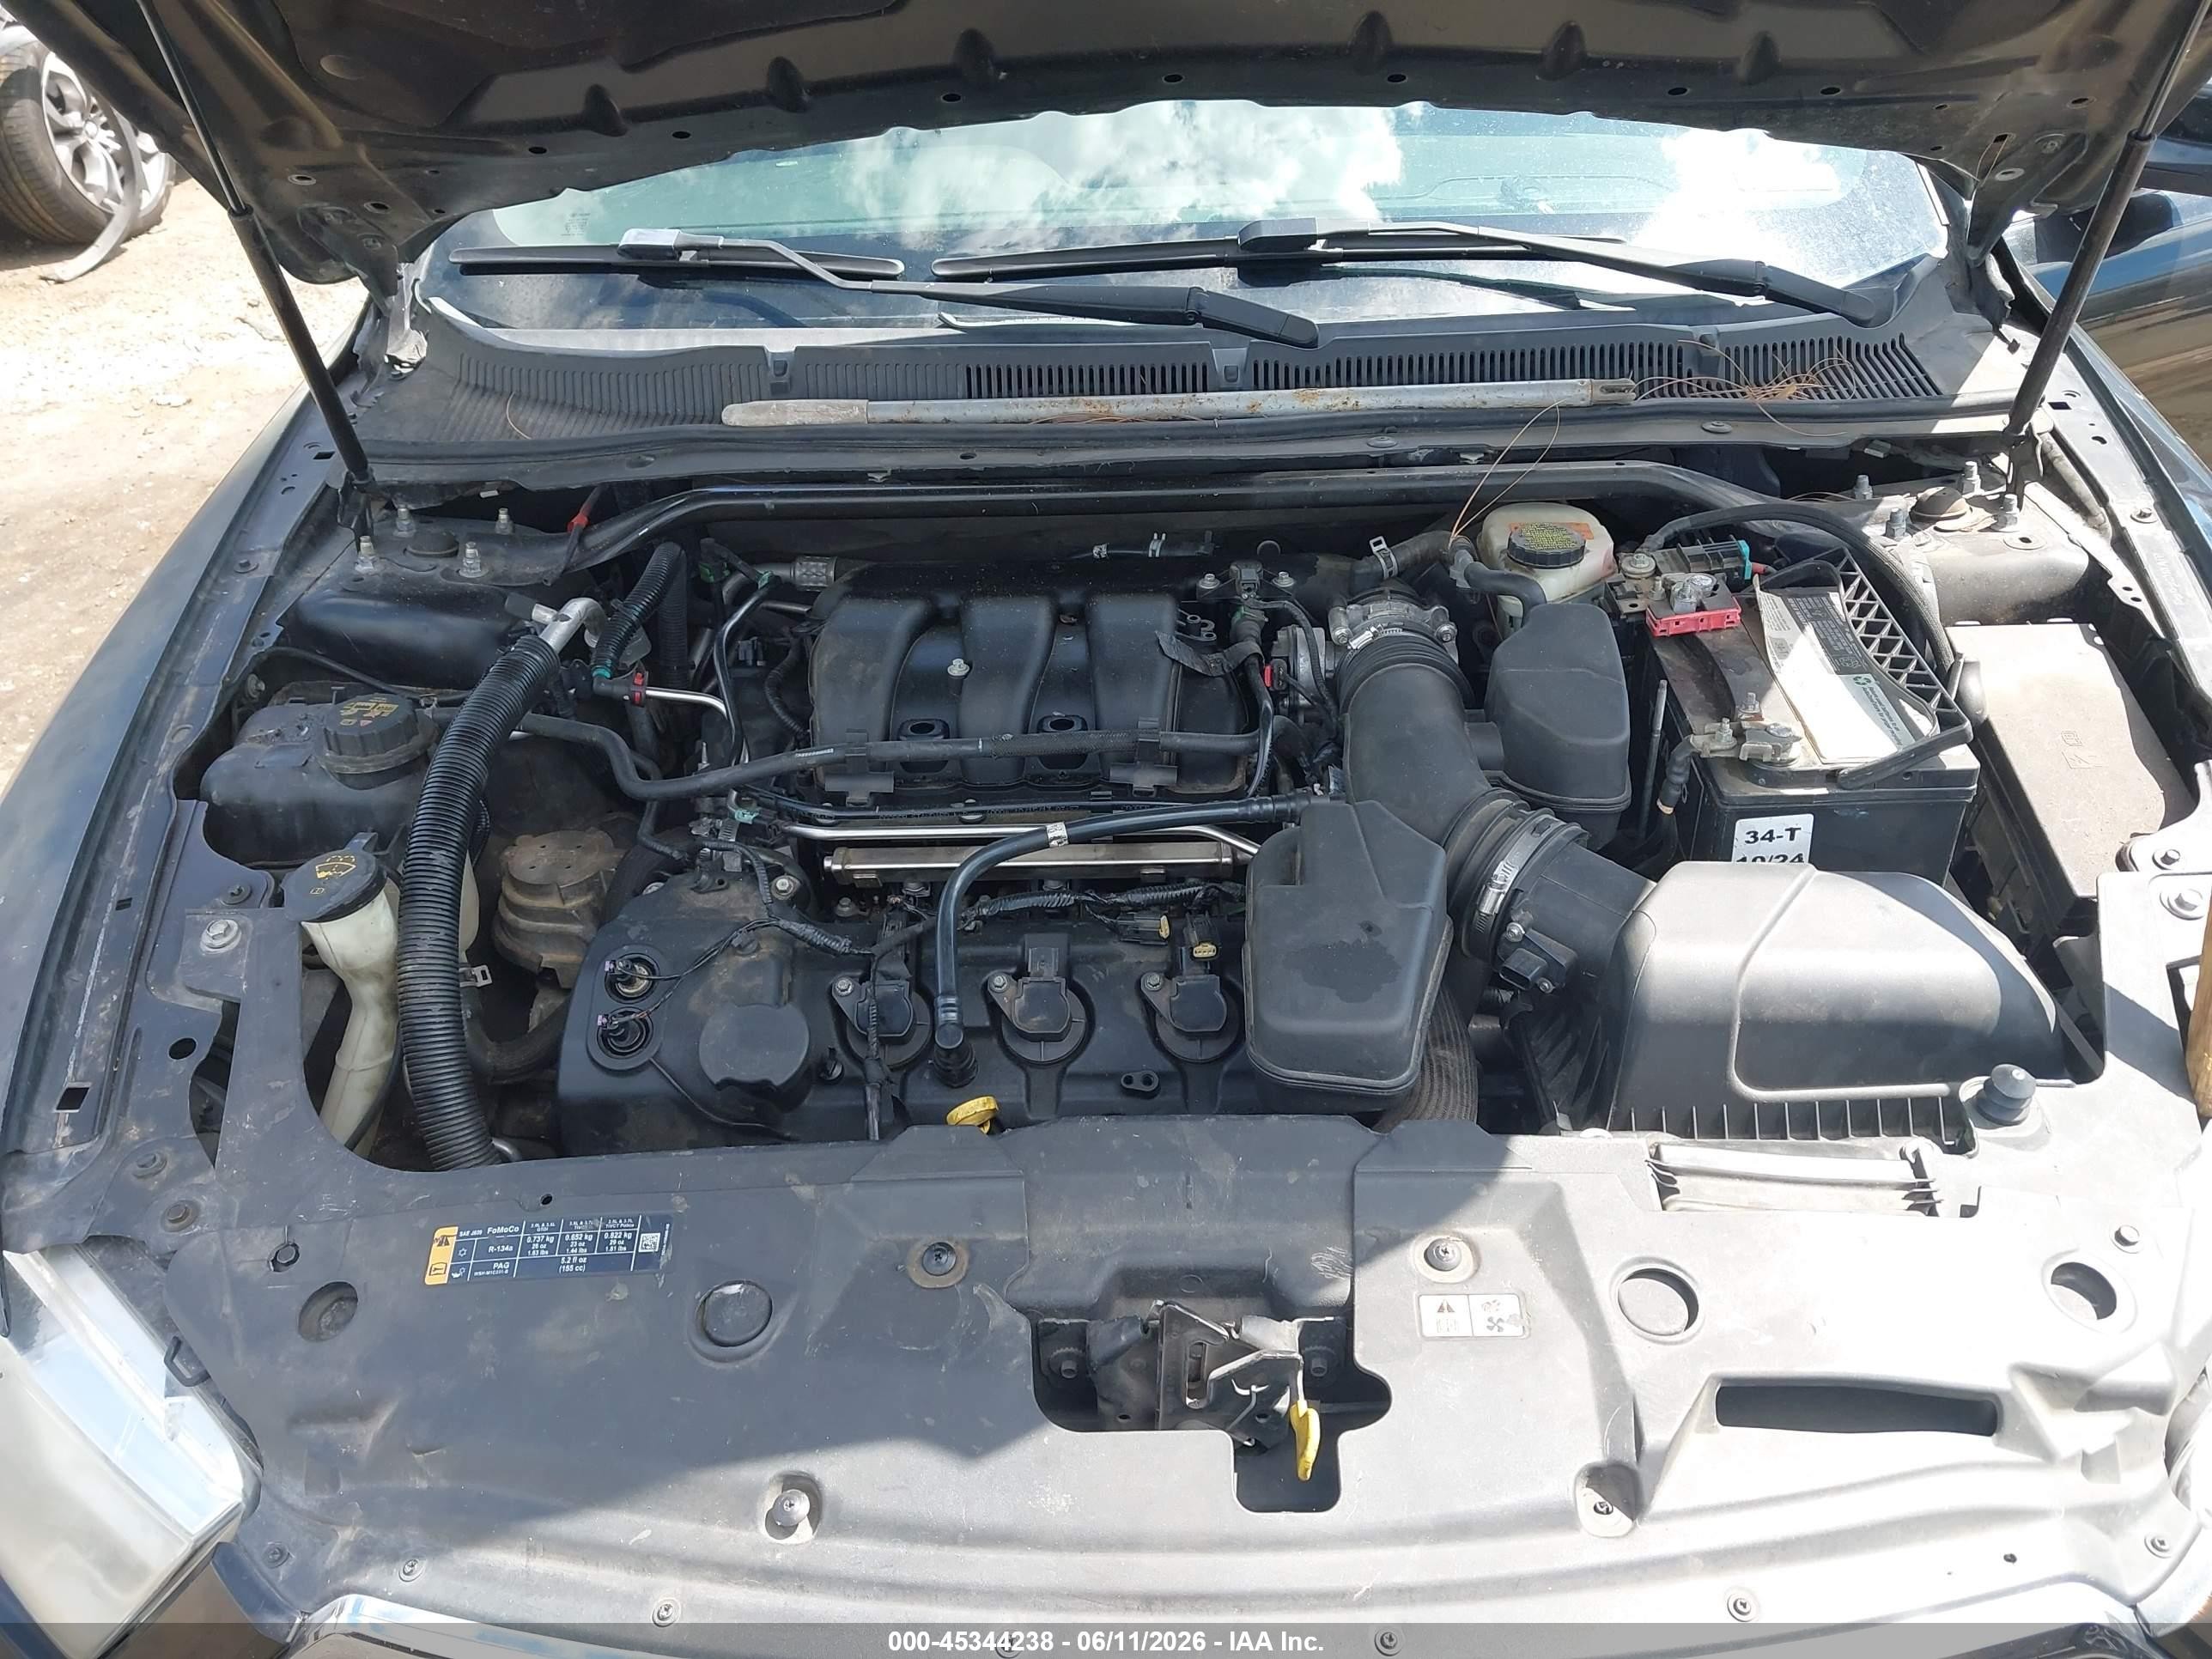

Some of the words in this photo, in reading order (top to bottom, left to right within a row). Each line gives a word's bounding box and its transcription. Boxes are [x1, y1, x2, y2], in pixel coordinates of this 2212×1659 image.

[1744, 826, 1802, 845] 34-T
[487, 1225, 520, 1235] FoMoCo
[526, 1235, 545, 1243] 0.737
[546, 1235, 555, 1243] kg
[584, 1233, 593, 1242] kg
[623, 1231, 632, 1240] kg
[488, 1245, 514, 1254] R-134a
[493, 1261, 510, 1270] PAG
[574, 1264, 586, 1273] cc)
